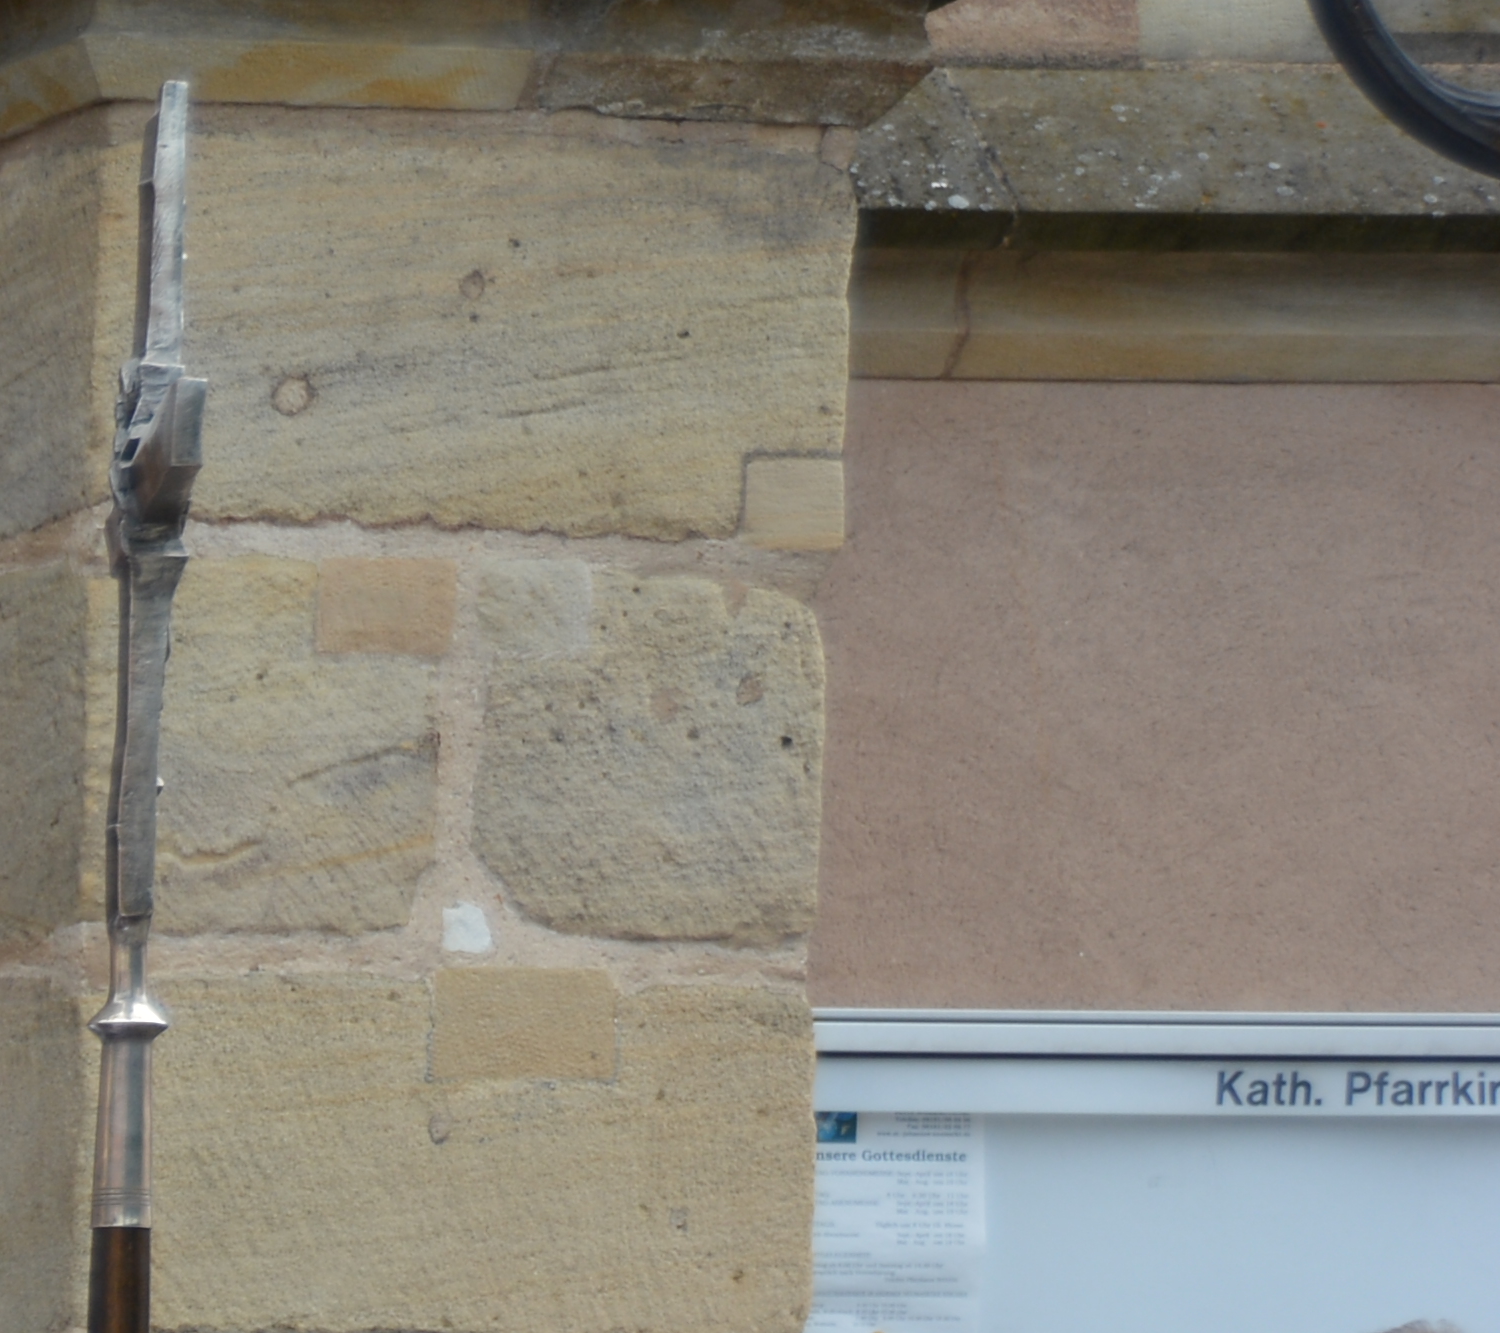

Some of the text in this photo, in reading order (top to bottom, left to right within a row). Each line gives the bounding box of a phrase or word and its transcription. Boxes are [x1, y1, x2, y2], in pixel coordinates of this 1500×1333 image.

[1216, 1070, 1322, 1106] Kath.
[815, 1150, 967, 1162] nsere Gottesdienste
